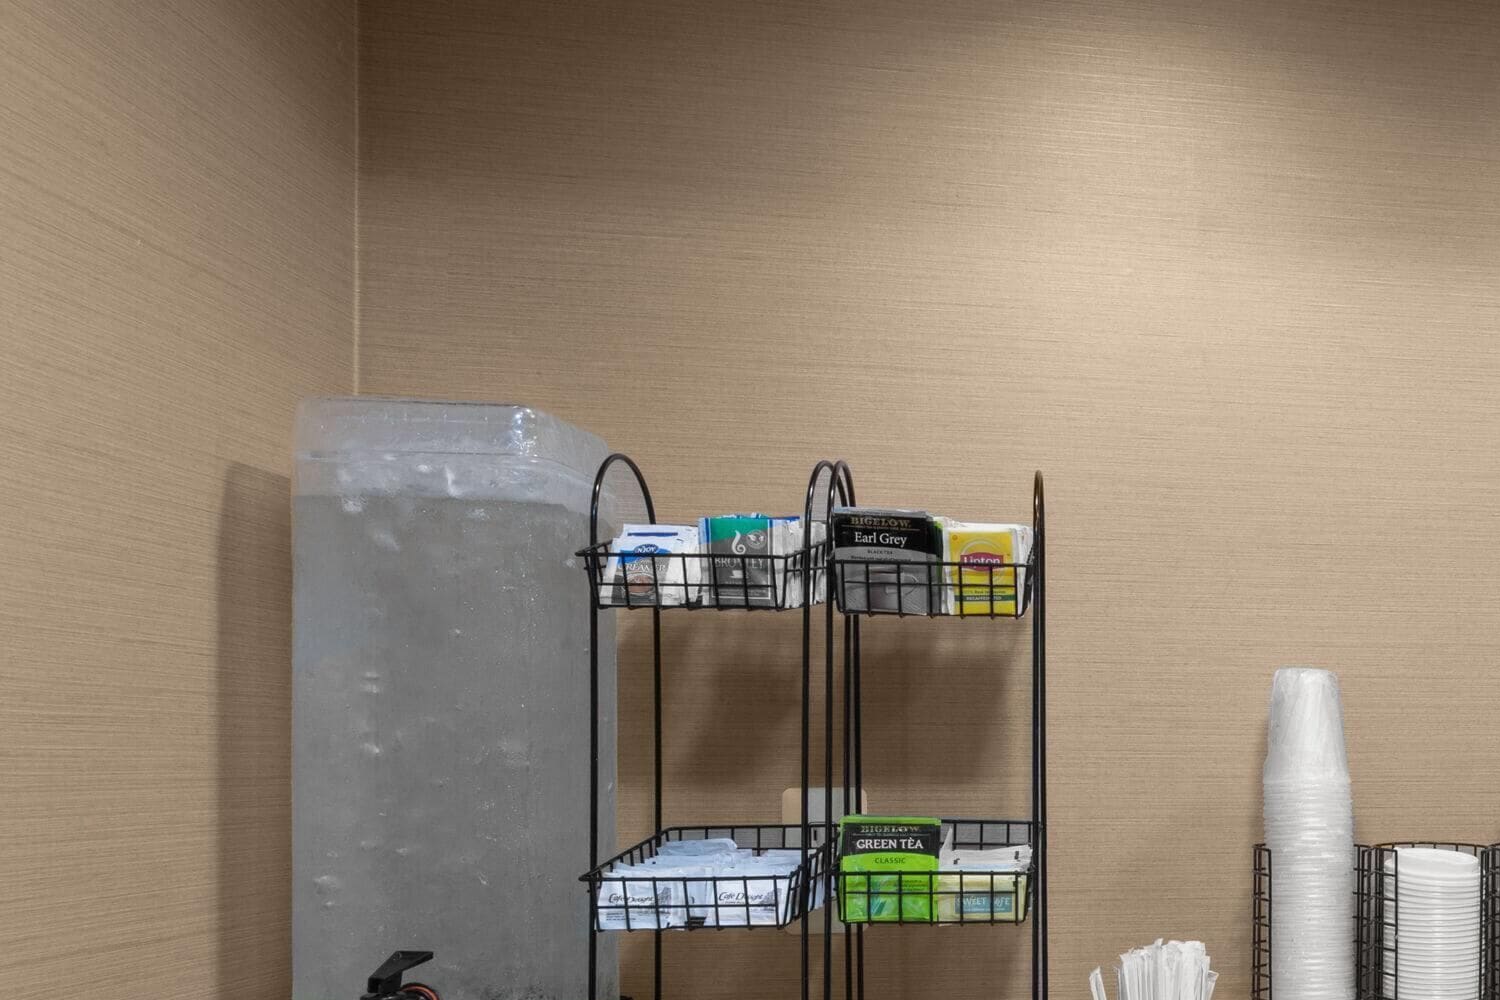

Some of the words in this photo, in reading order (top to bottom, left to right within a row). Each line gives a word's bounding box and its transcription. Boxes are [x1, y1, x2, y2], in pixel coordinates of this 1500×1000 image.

[854, 531, 877, 544] Earl
[879, 533, 908, 550] Grey
[856, 839, 897, 849] GREEN
